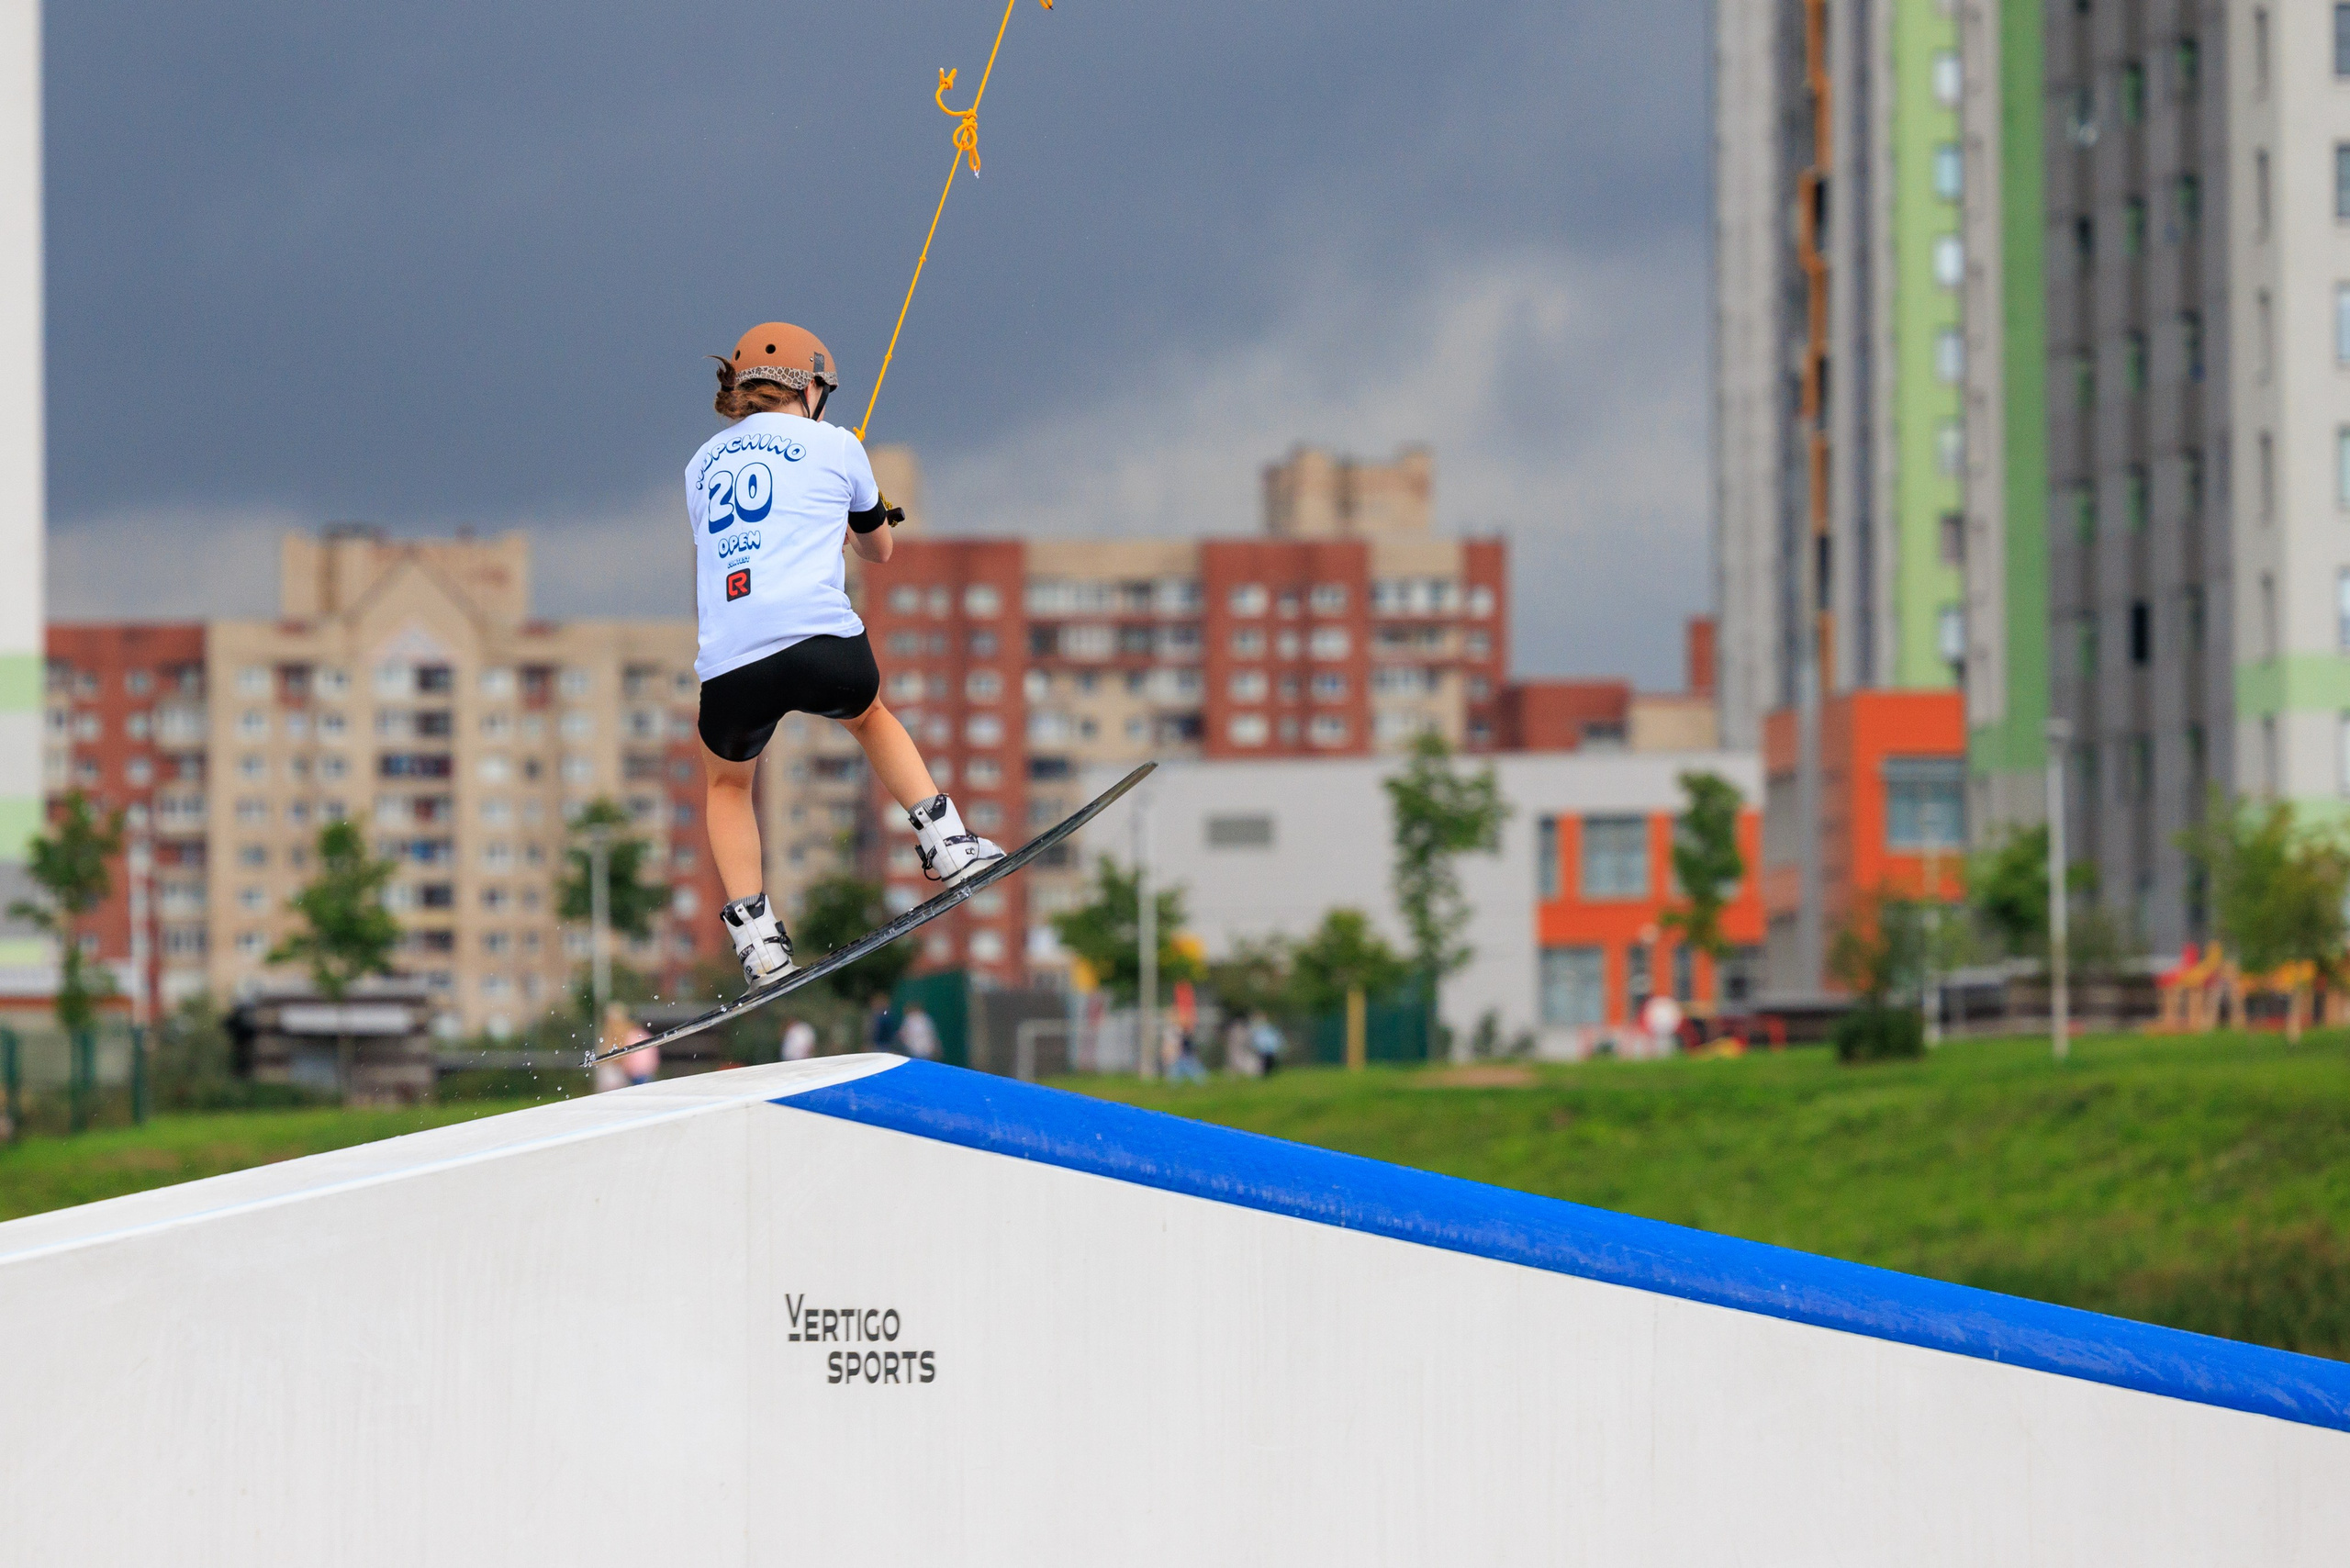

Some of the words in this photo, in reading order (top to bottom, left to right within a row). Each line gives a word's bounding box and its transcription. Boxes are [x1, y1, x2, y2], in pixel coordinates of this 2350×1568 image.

[709, 462, 773, 534] 20
[718, 530, 761, 558] OPEN
[785, 1294, 901, 1341] VERTIGO
[827, 1350, 935, 1383] SPORTS
